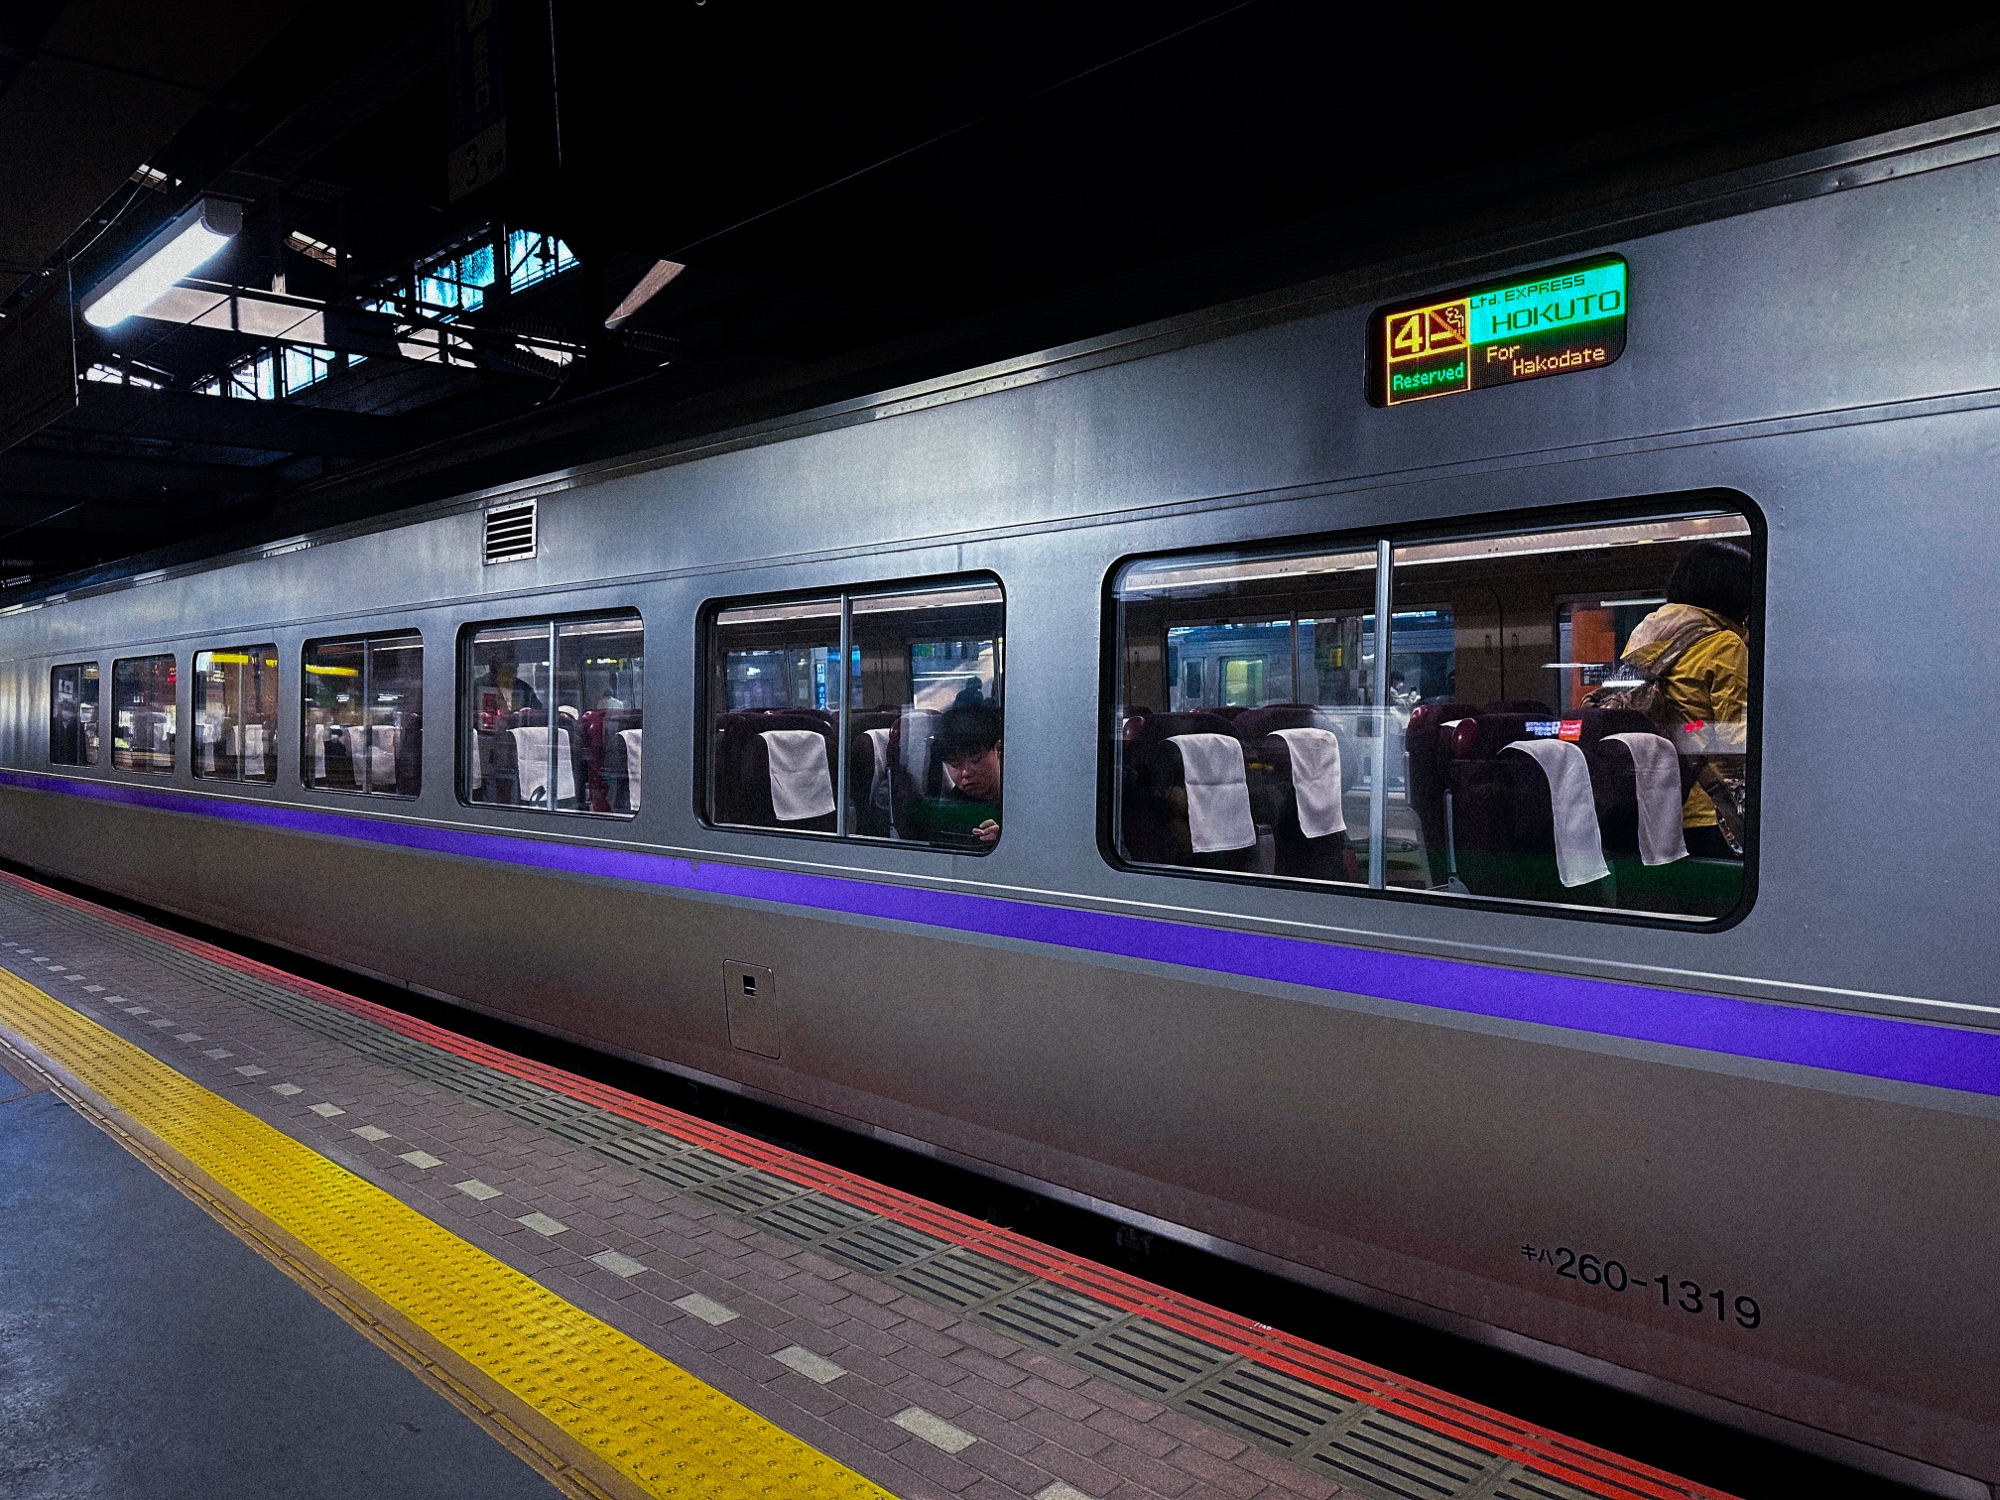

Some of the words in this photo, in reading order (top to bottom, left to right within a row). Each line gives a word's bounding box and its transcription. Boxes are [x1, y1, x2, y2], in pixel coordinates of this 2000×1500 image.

[1470, 294, 1501, 310] Ltd.
[1504, 274, 1586, 301] EXPRESS
[1491, 289, 1621, 334] HOKUTO
[1393, 314, 1424, 353] 4
[1486, 344, 1521, 363] For
[1512, 346, 1606, 376] Hakodate
[1392, 361, 1465, 391] Reserved
